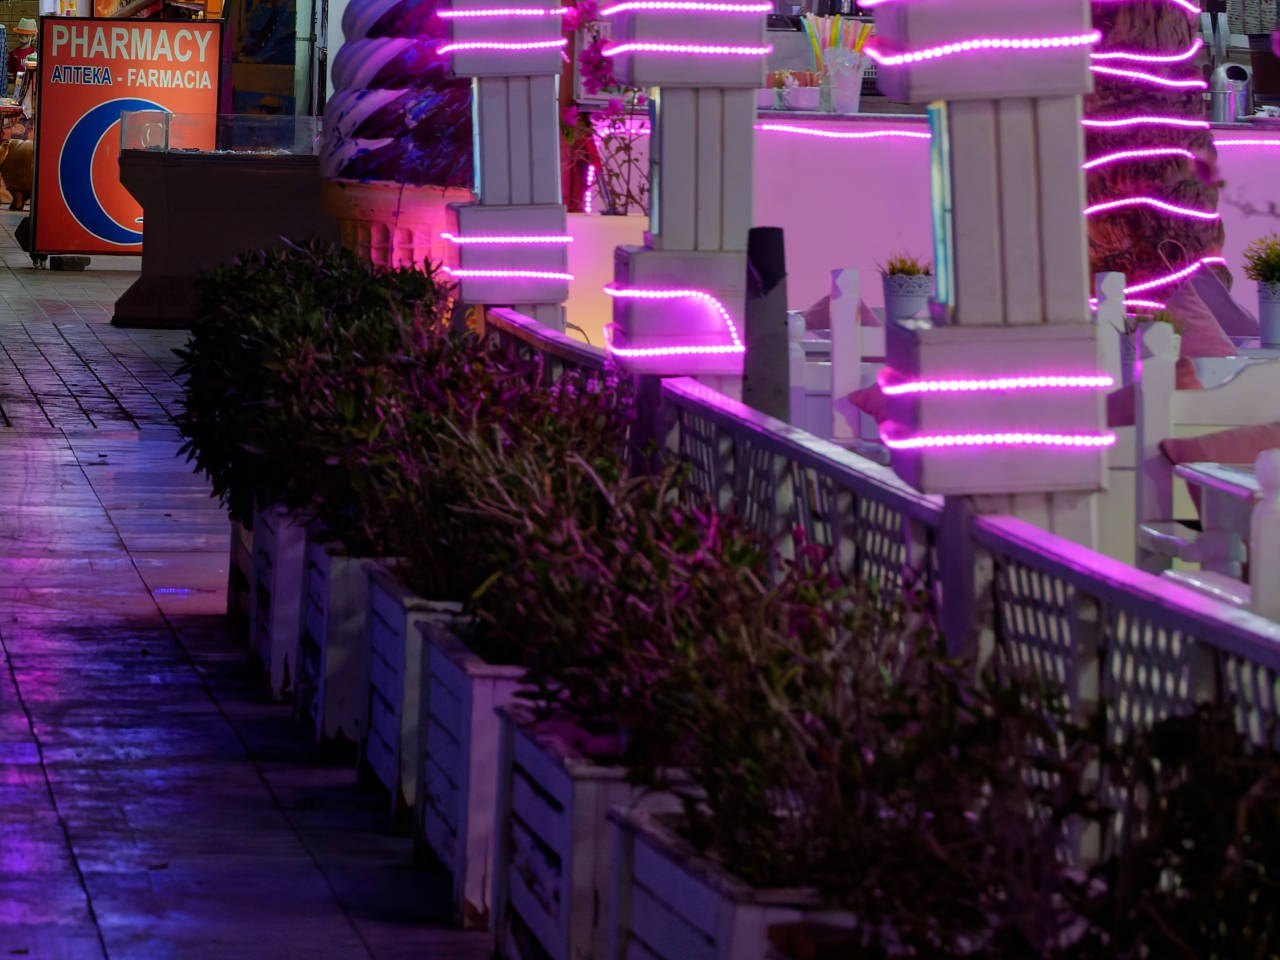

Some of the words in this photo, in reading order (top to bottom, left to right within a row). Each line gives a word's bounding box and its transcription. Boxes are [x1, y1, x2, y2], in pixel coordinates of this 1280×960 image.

[51, 24, 213, 63] PHARMACY
[50, 65, 113, 86] АПТЕКА
[127, 68, 212, 89] FARMACIA
